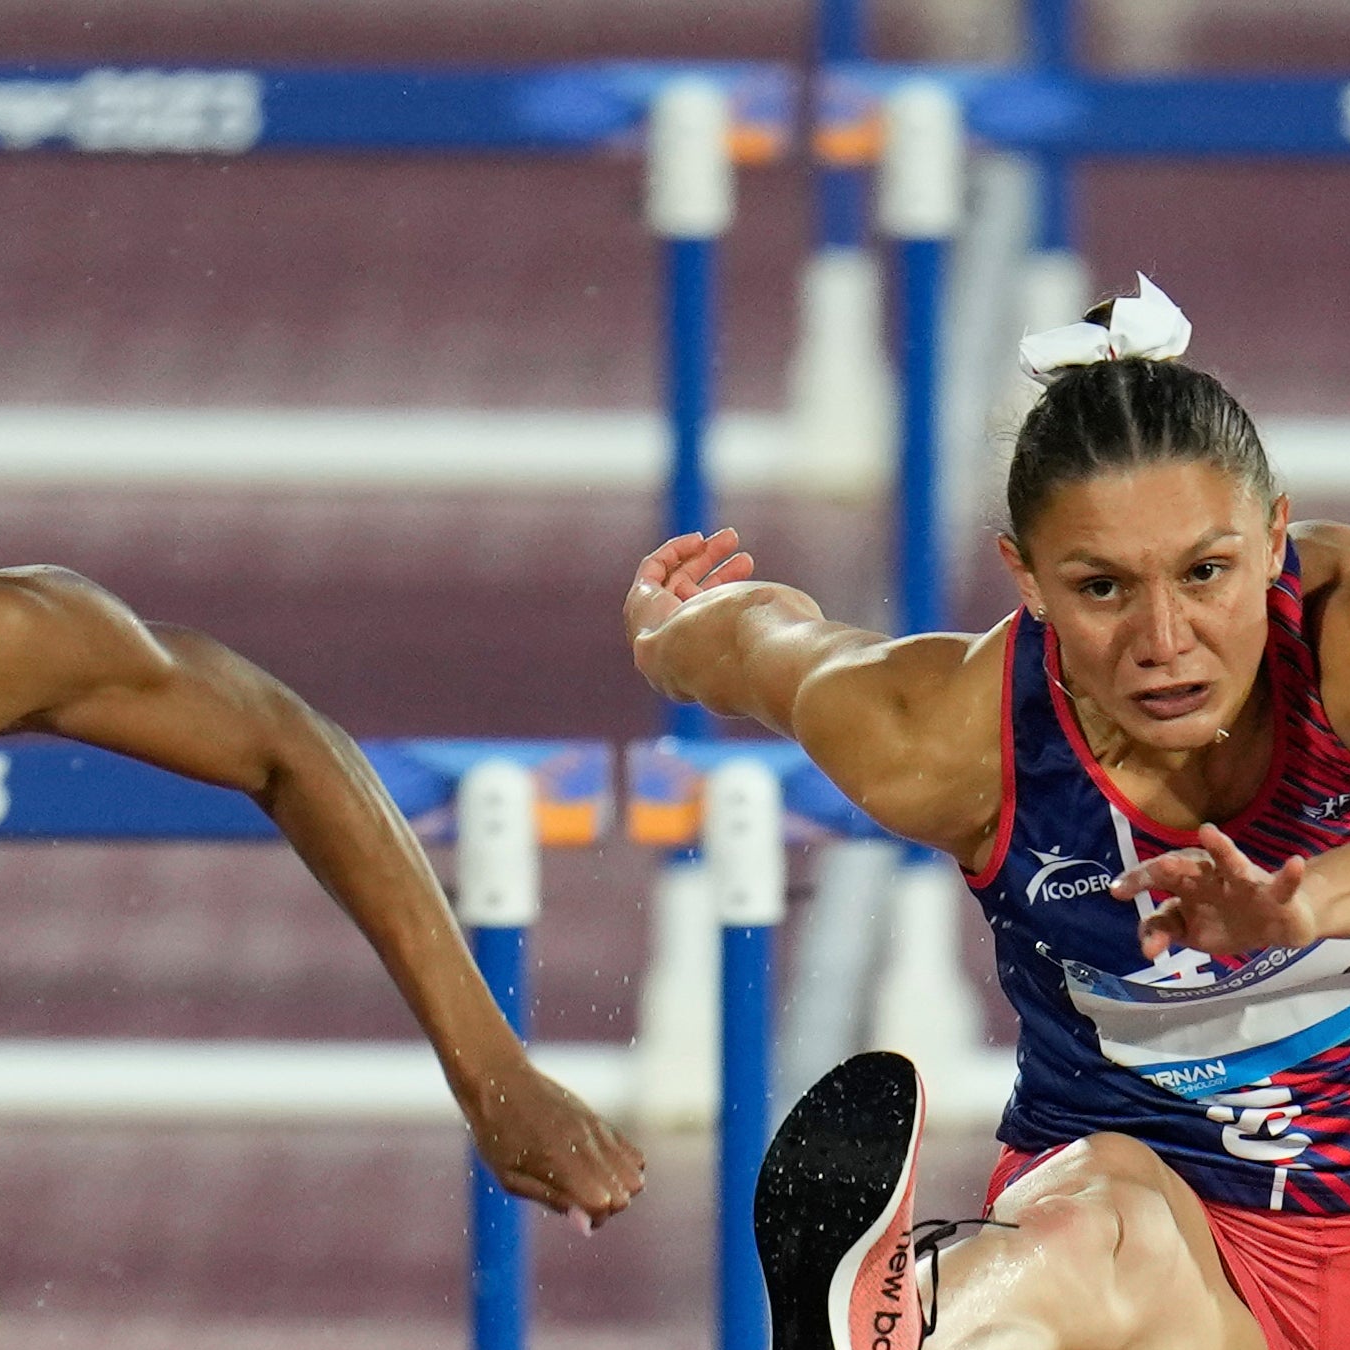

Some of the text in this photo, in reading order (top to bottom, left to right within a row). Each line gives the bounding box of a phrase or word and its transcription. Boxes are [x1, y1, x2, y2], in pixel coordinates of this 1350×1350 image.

[1042, 873, 1112, 902] ICODER
[1156, 947, 1301, 999] Santiago 202
[882, 1231, 911, 1302] new
